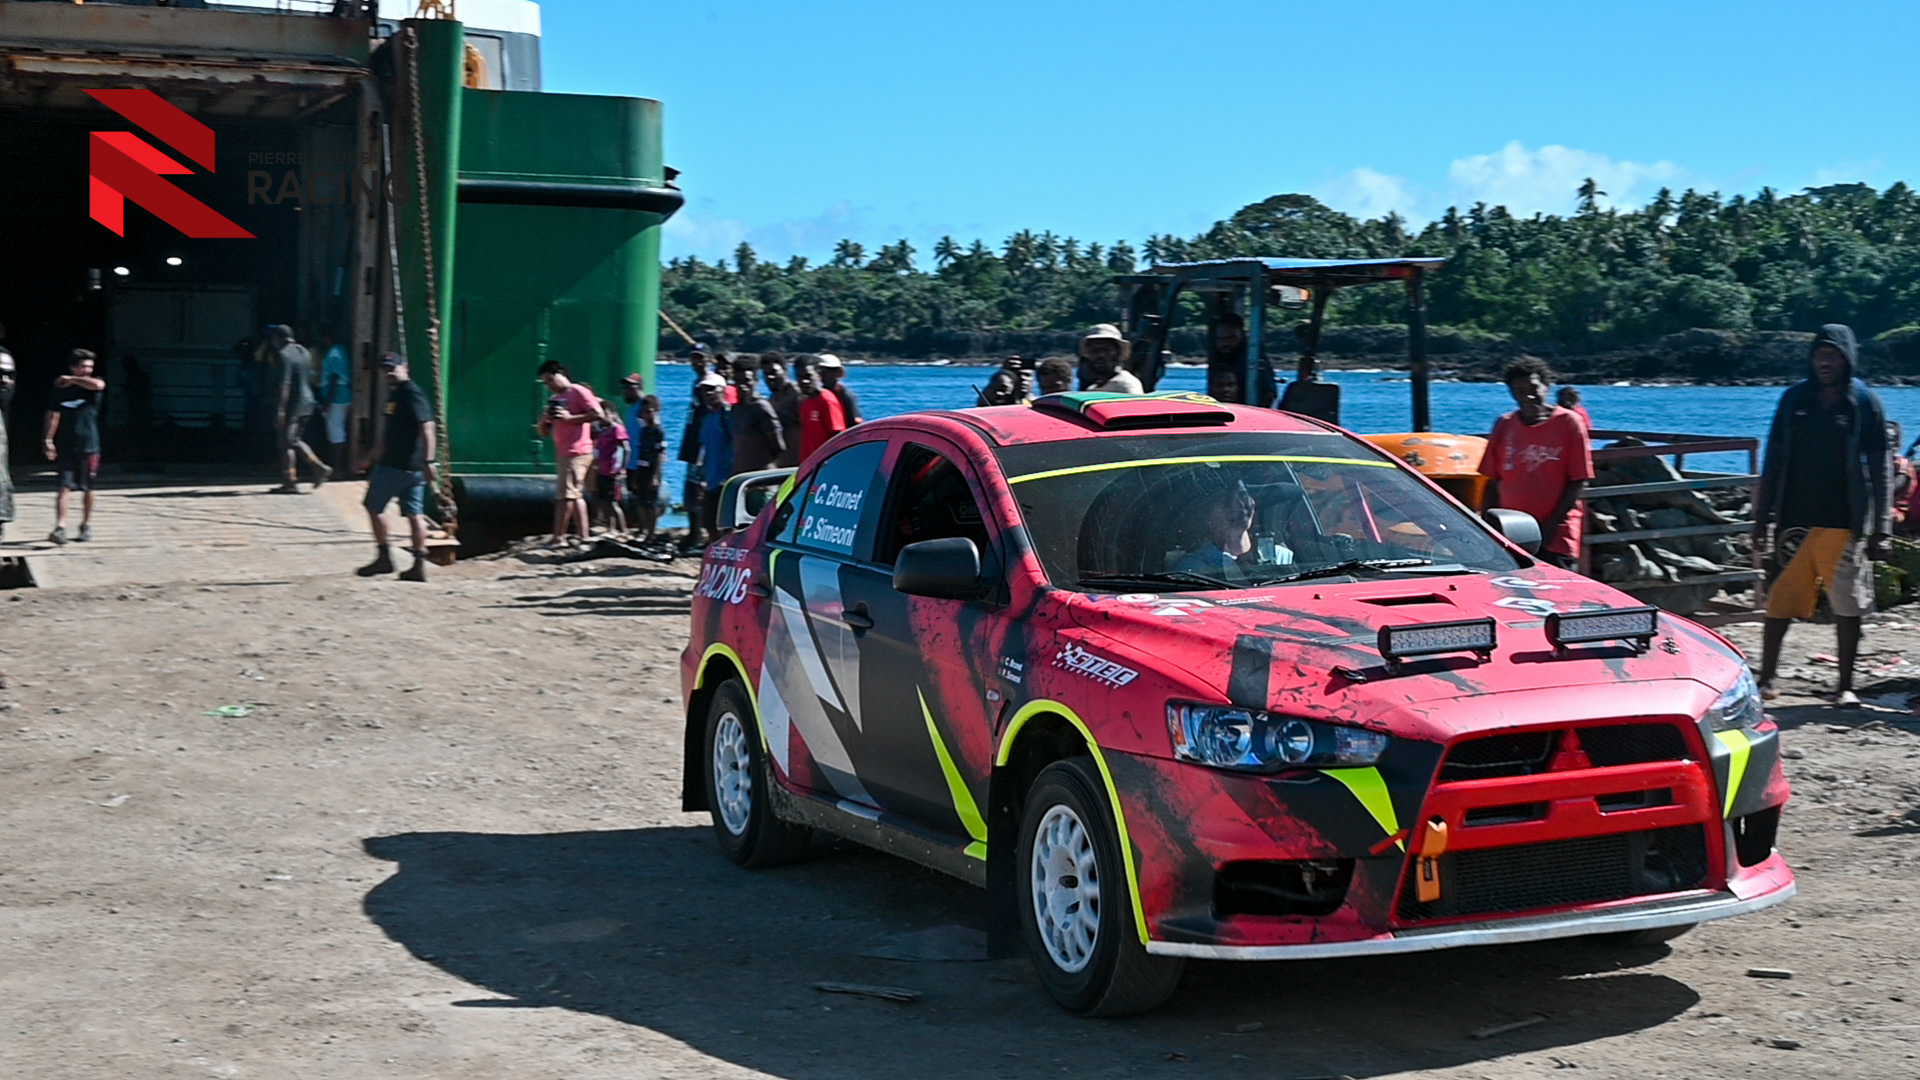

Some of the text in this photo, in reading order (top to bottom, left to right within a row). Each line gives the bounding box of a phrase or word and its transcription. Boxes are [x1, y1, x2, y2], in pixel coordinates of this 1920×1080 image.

[814, 483, 864, 511] C. Brunet
[801, 515, 858, 547] P. Simeoni
[695, 563, 752, 605] RACING
